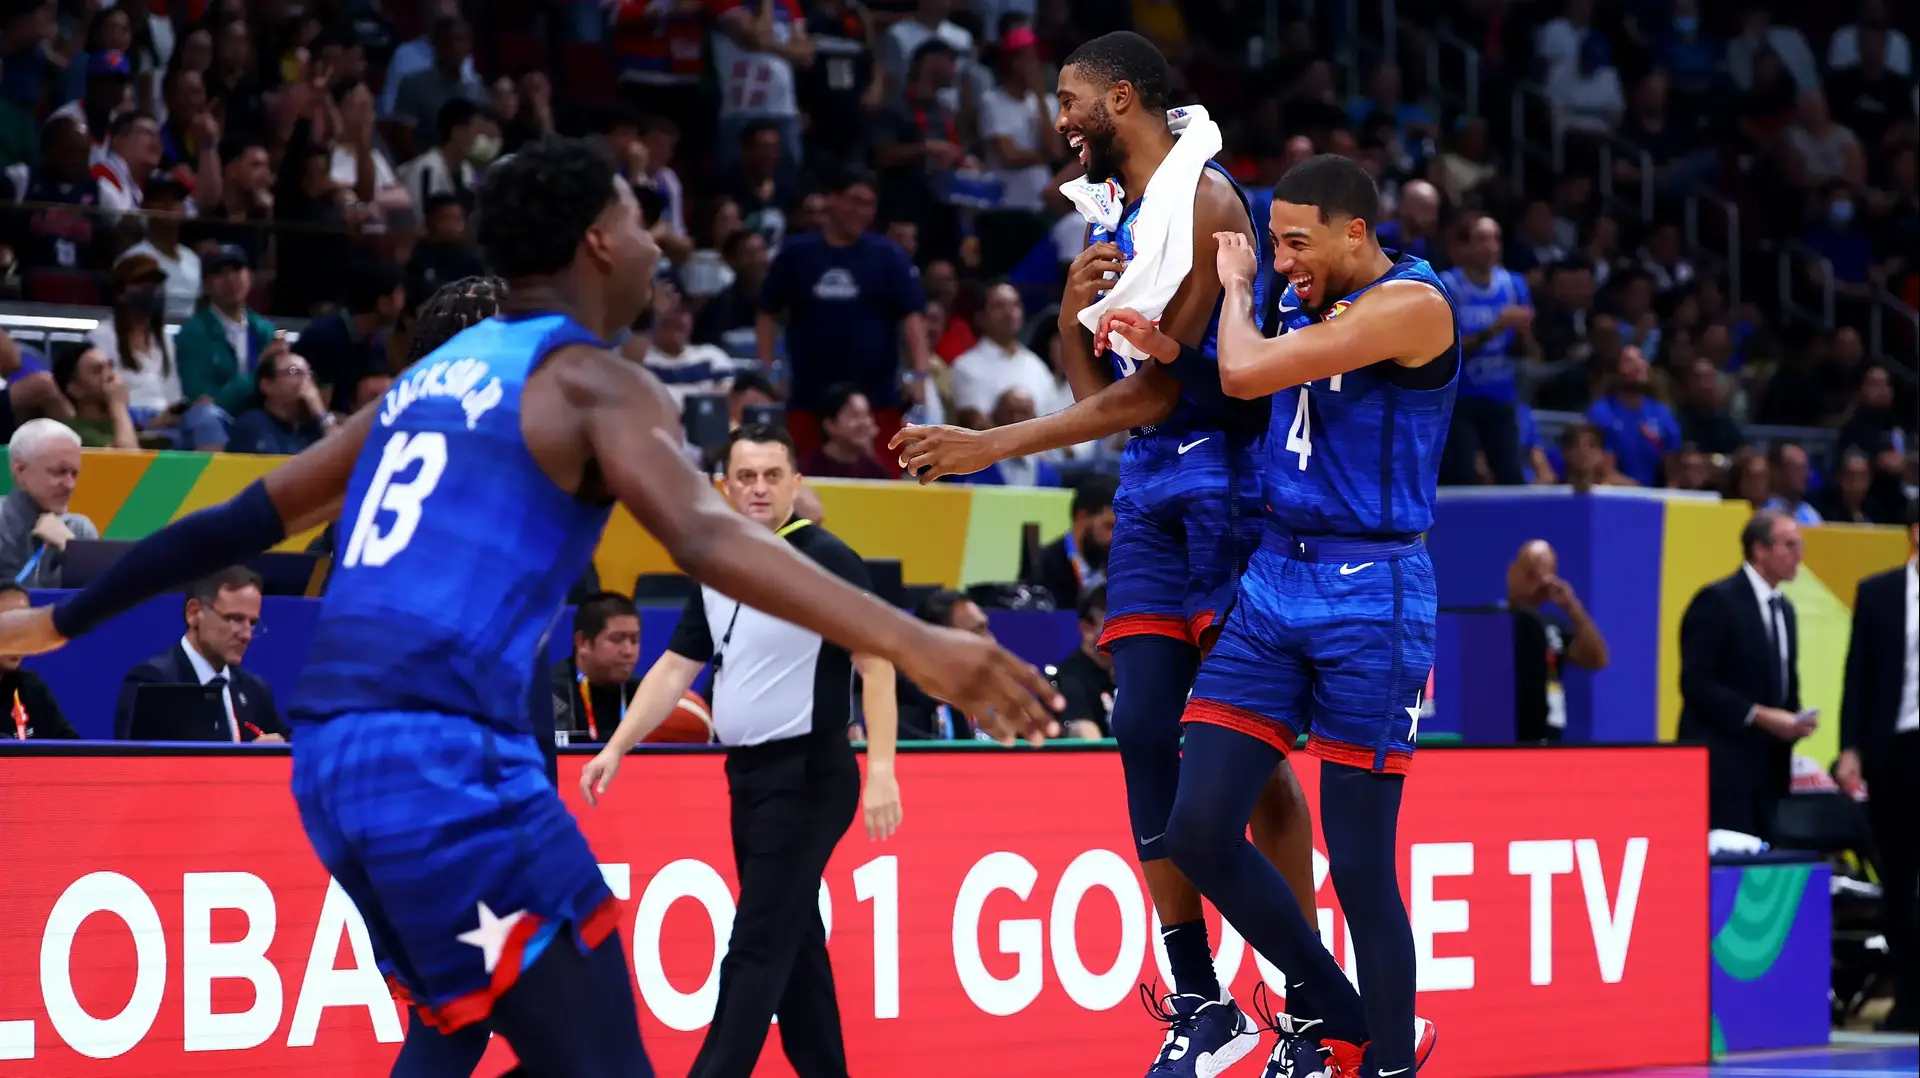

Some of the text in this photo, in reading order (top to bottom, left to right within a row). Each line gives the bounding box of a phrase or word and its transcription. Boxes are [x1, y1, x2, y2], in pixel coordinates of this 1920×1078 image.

[1285, 387, 1312, 472] 4
[342, 431, 448, 568] 13
[1508, 837, 1649, 984] TV
